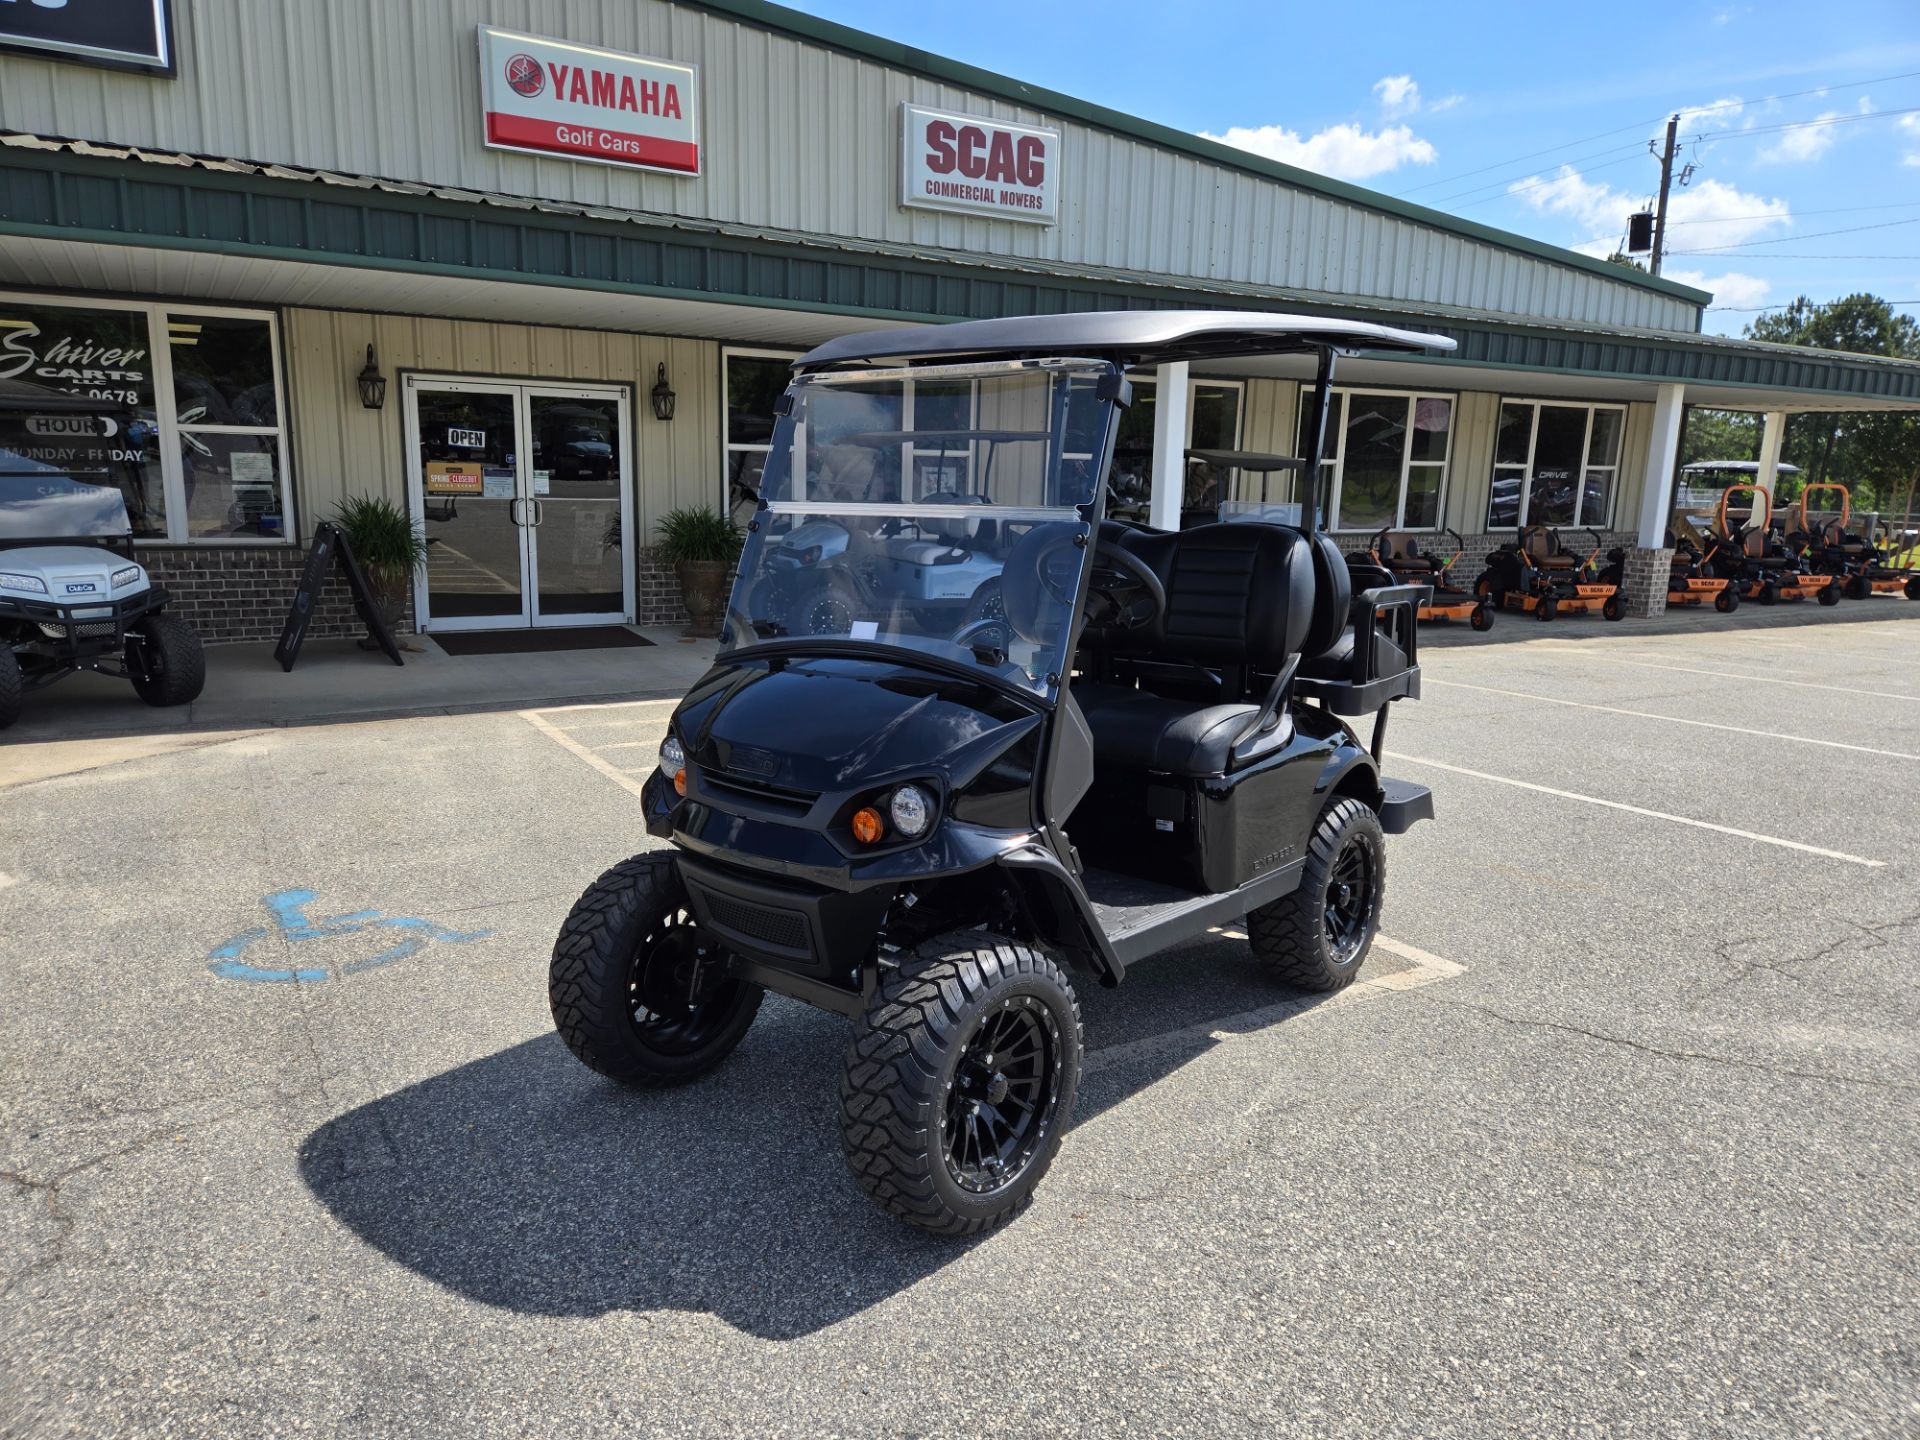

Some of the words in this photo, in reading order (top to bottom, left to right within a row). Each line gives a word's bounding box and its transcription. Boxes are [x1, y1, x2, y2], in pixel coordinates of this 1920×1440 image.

[548, 62, 682, 120] YAMAHA
[556, 126, 593, 147] Golf
[599, 132, 640, 154] Cars
[926, 119, 1045, 188] SCAG
[926, 180, 996, 204] COMMERCIAL
[1000, 190, 1043, 209] MOWERS
[0, 328, 146, 379] Shiver
[35, 367, 144, 381] CARTS
[36, 418, 98, 434] HOUR
[451, 429, 483, 446] OPEN
[1538, 471, 1569, 479] DRIVE
